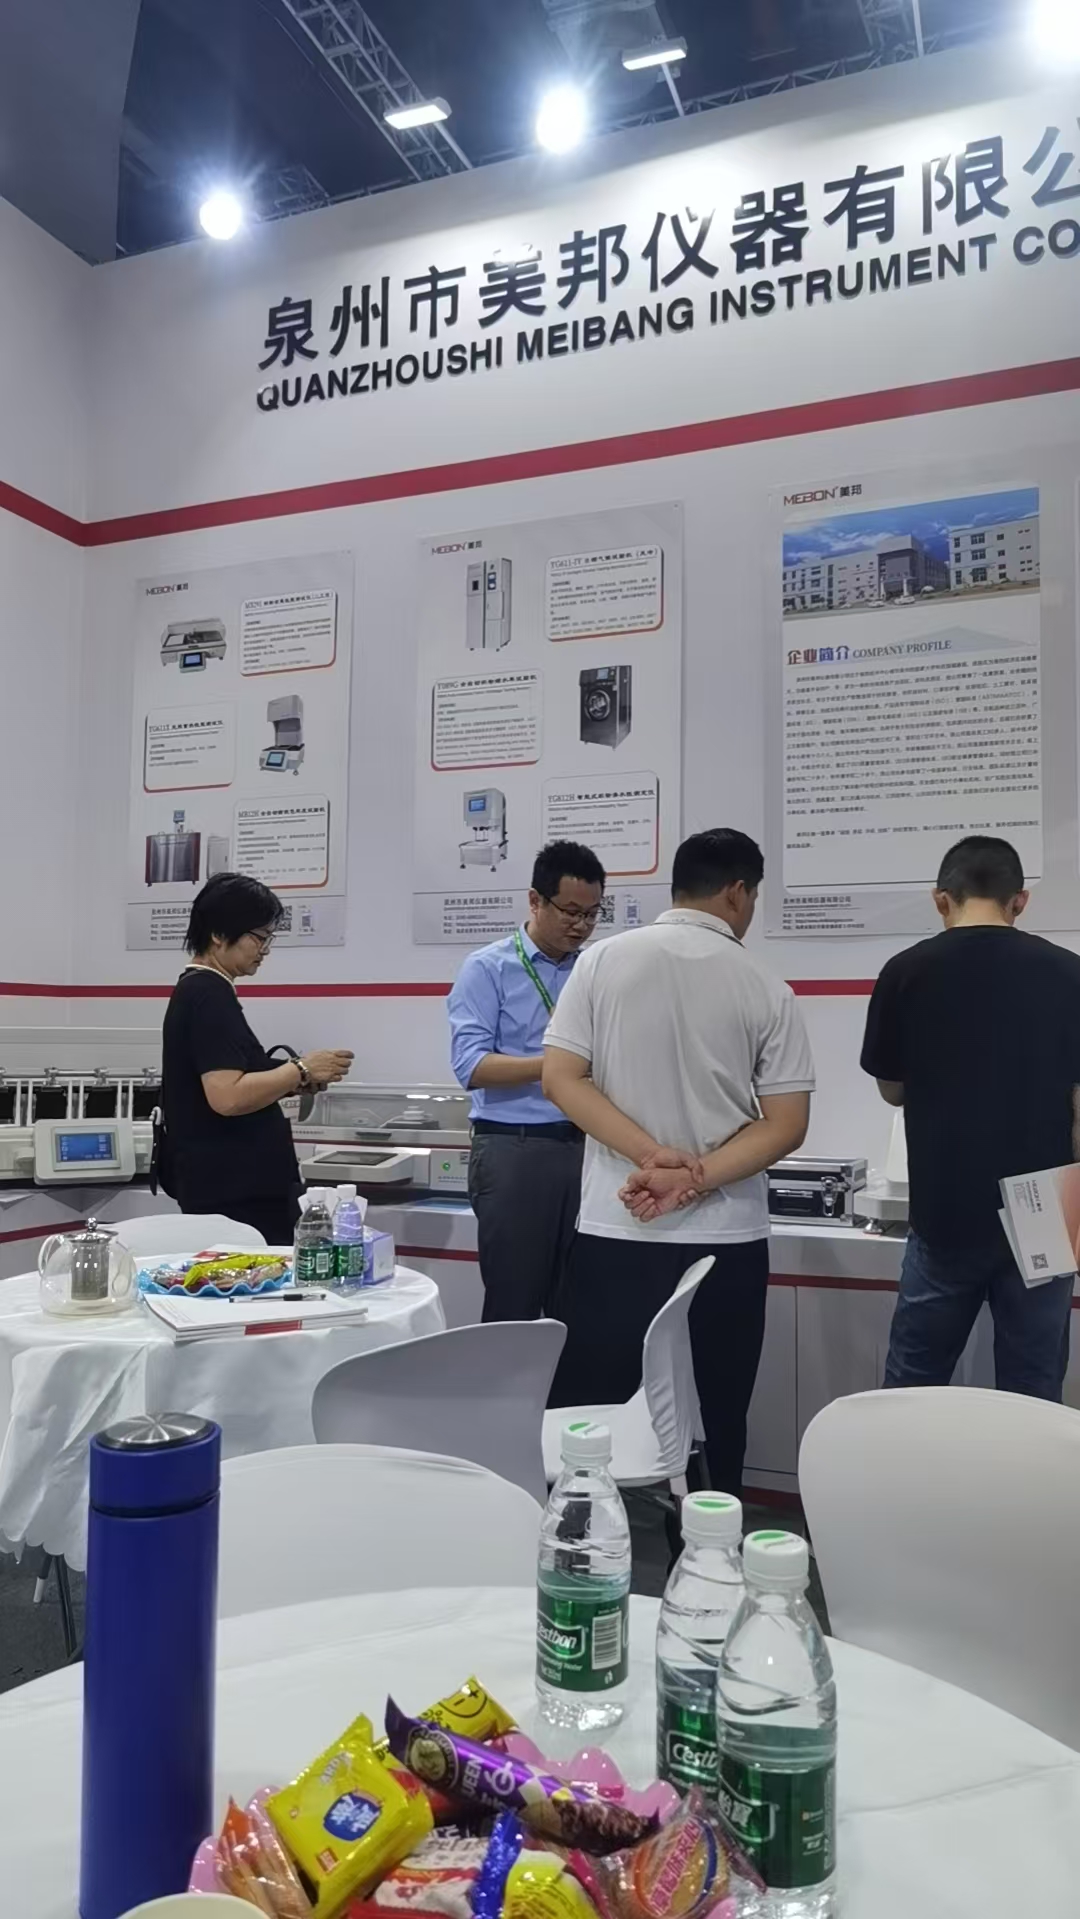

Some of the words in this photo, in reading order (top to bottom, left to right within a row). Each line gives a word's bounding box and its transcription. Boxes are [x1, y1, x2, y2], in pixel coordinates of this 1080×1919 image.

[256, 336, 503, 412] QUANZHOUSHI
[517, 297, 694, 363] MEIBANG
[710, 233, 997, 324] INSTRUMENT
[840, 484, 862, 497] 美邦
[787, 645, 849, 665] 企业简介
[852, 643, 905, 658] COMPANY
[906, 639, 952, 653] PROFILE
